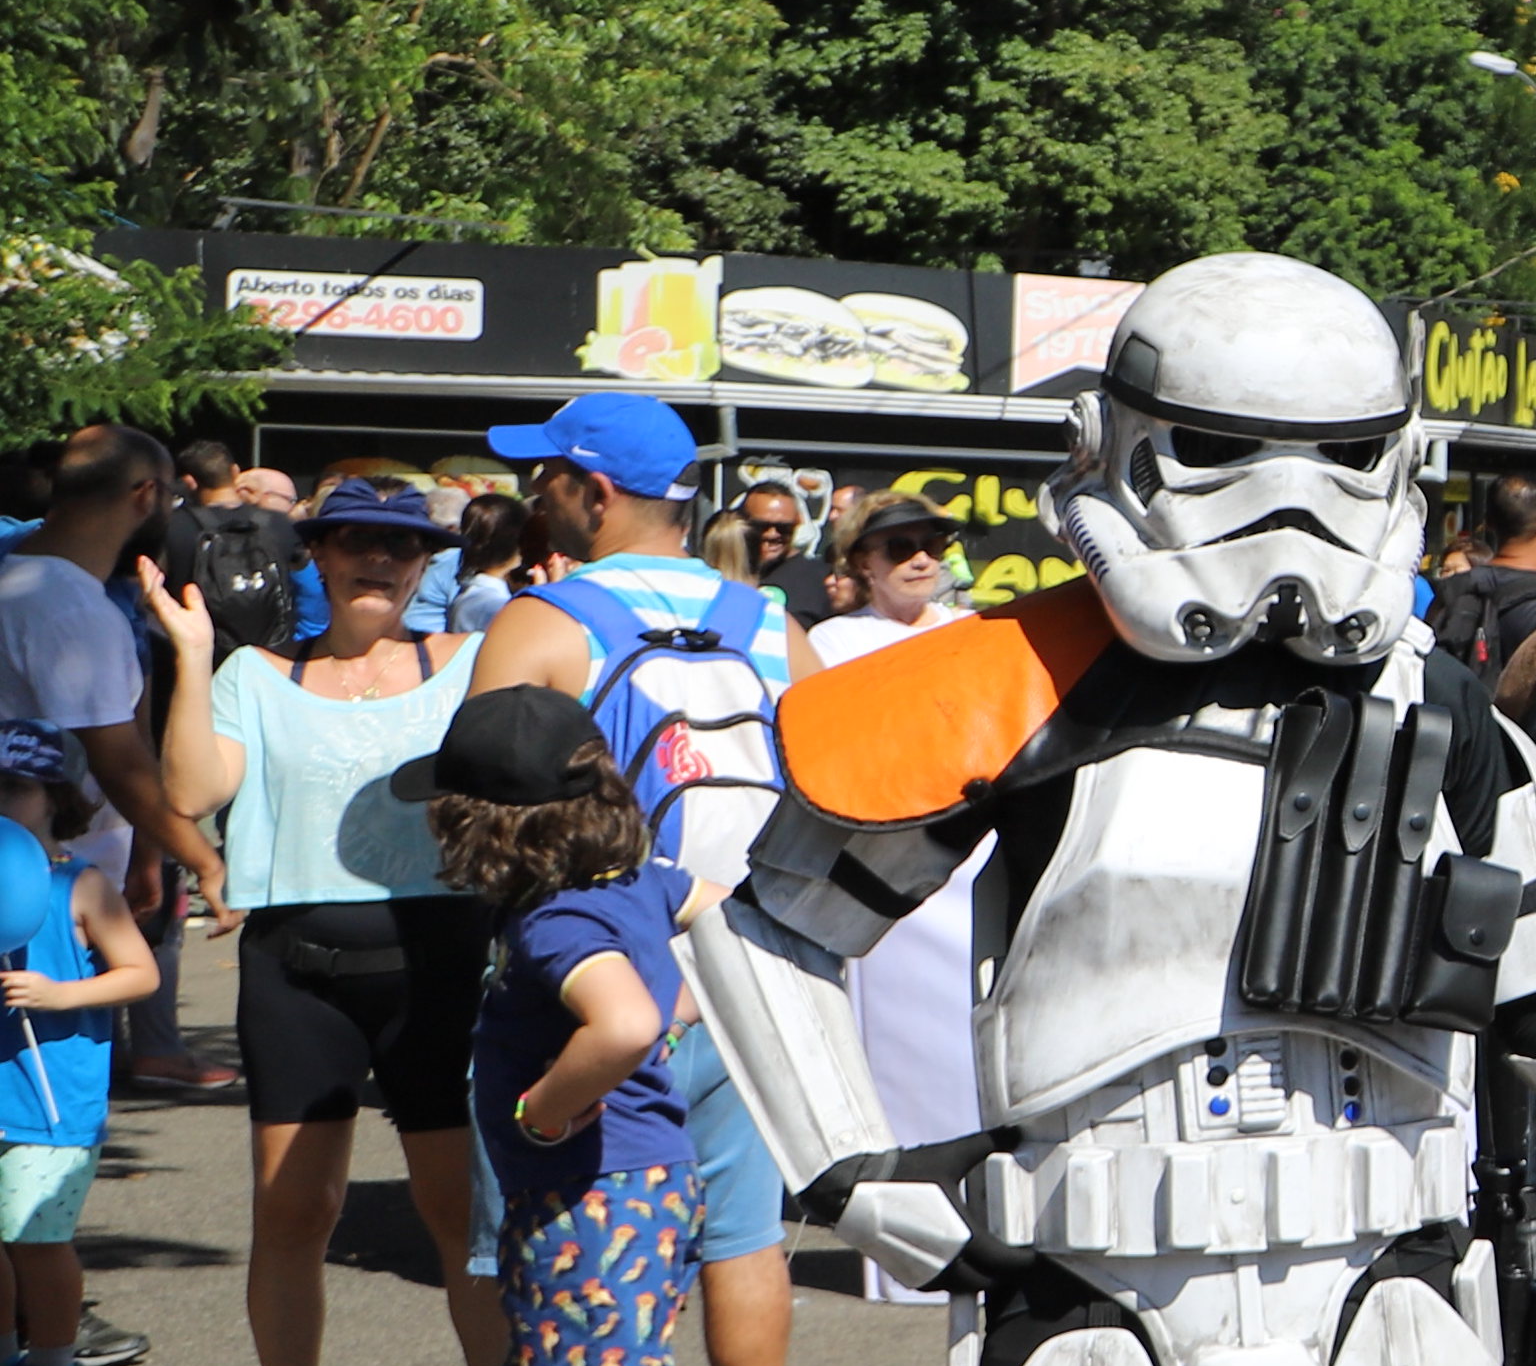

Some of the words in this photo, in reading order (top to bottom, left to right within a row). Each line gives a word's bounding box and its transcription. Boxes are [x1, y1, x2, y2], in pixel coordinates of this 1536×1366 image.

[236, 276, 314, 295] Aberto
[394, 285, 419, 300] os
[428, 284, 475, 302] dias
